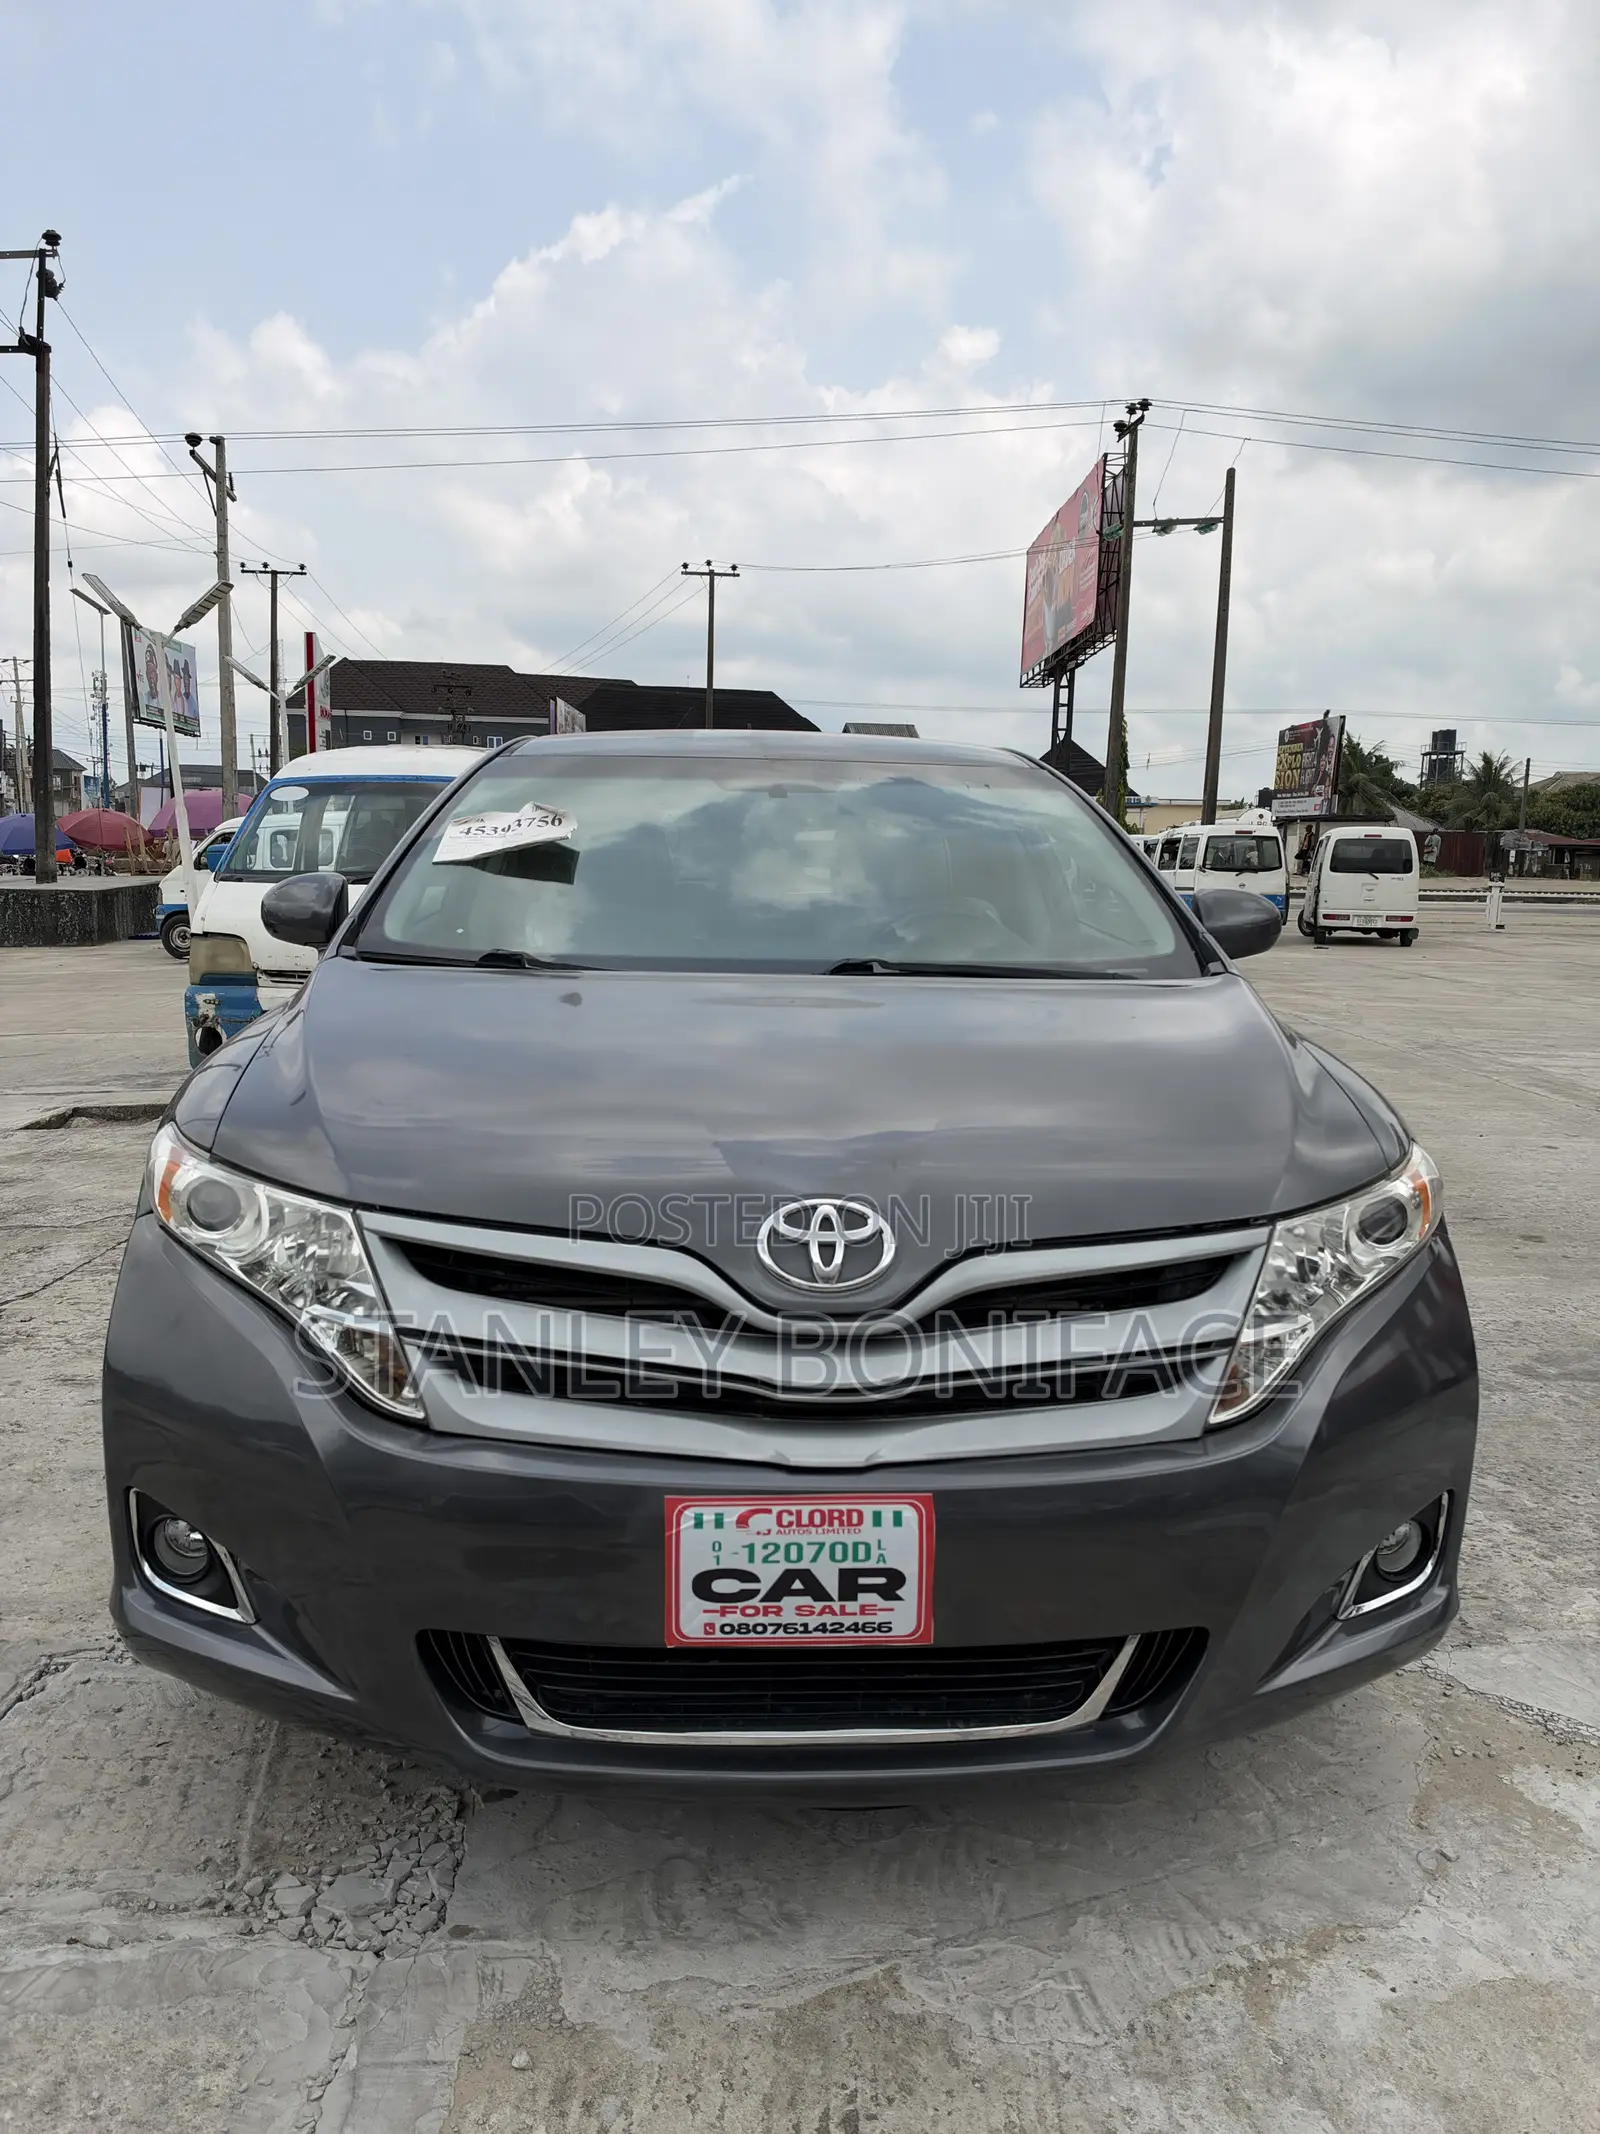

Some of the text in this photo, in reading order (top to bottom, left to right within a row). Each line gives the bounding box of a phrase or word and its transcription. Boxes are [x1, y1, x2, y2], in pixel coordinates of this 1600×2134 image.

[776, 1509, 863, 1528] CLORD
[776, 1527, 862, 1536] AUTOS LIMITED
[691, 1567, 906, 1604] CAR
[719, 1621, 893, 1635] 08076142466
